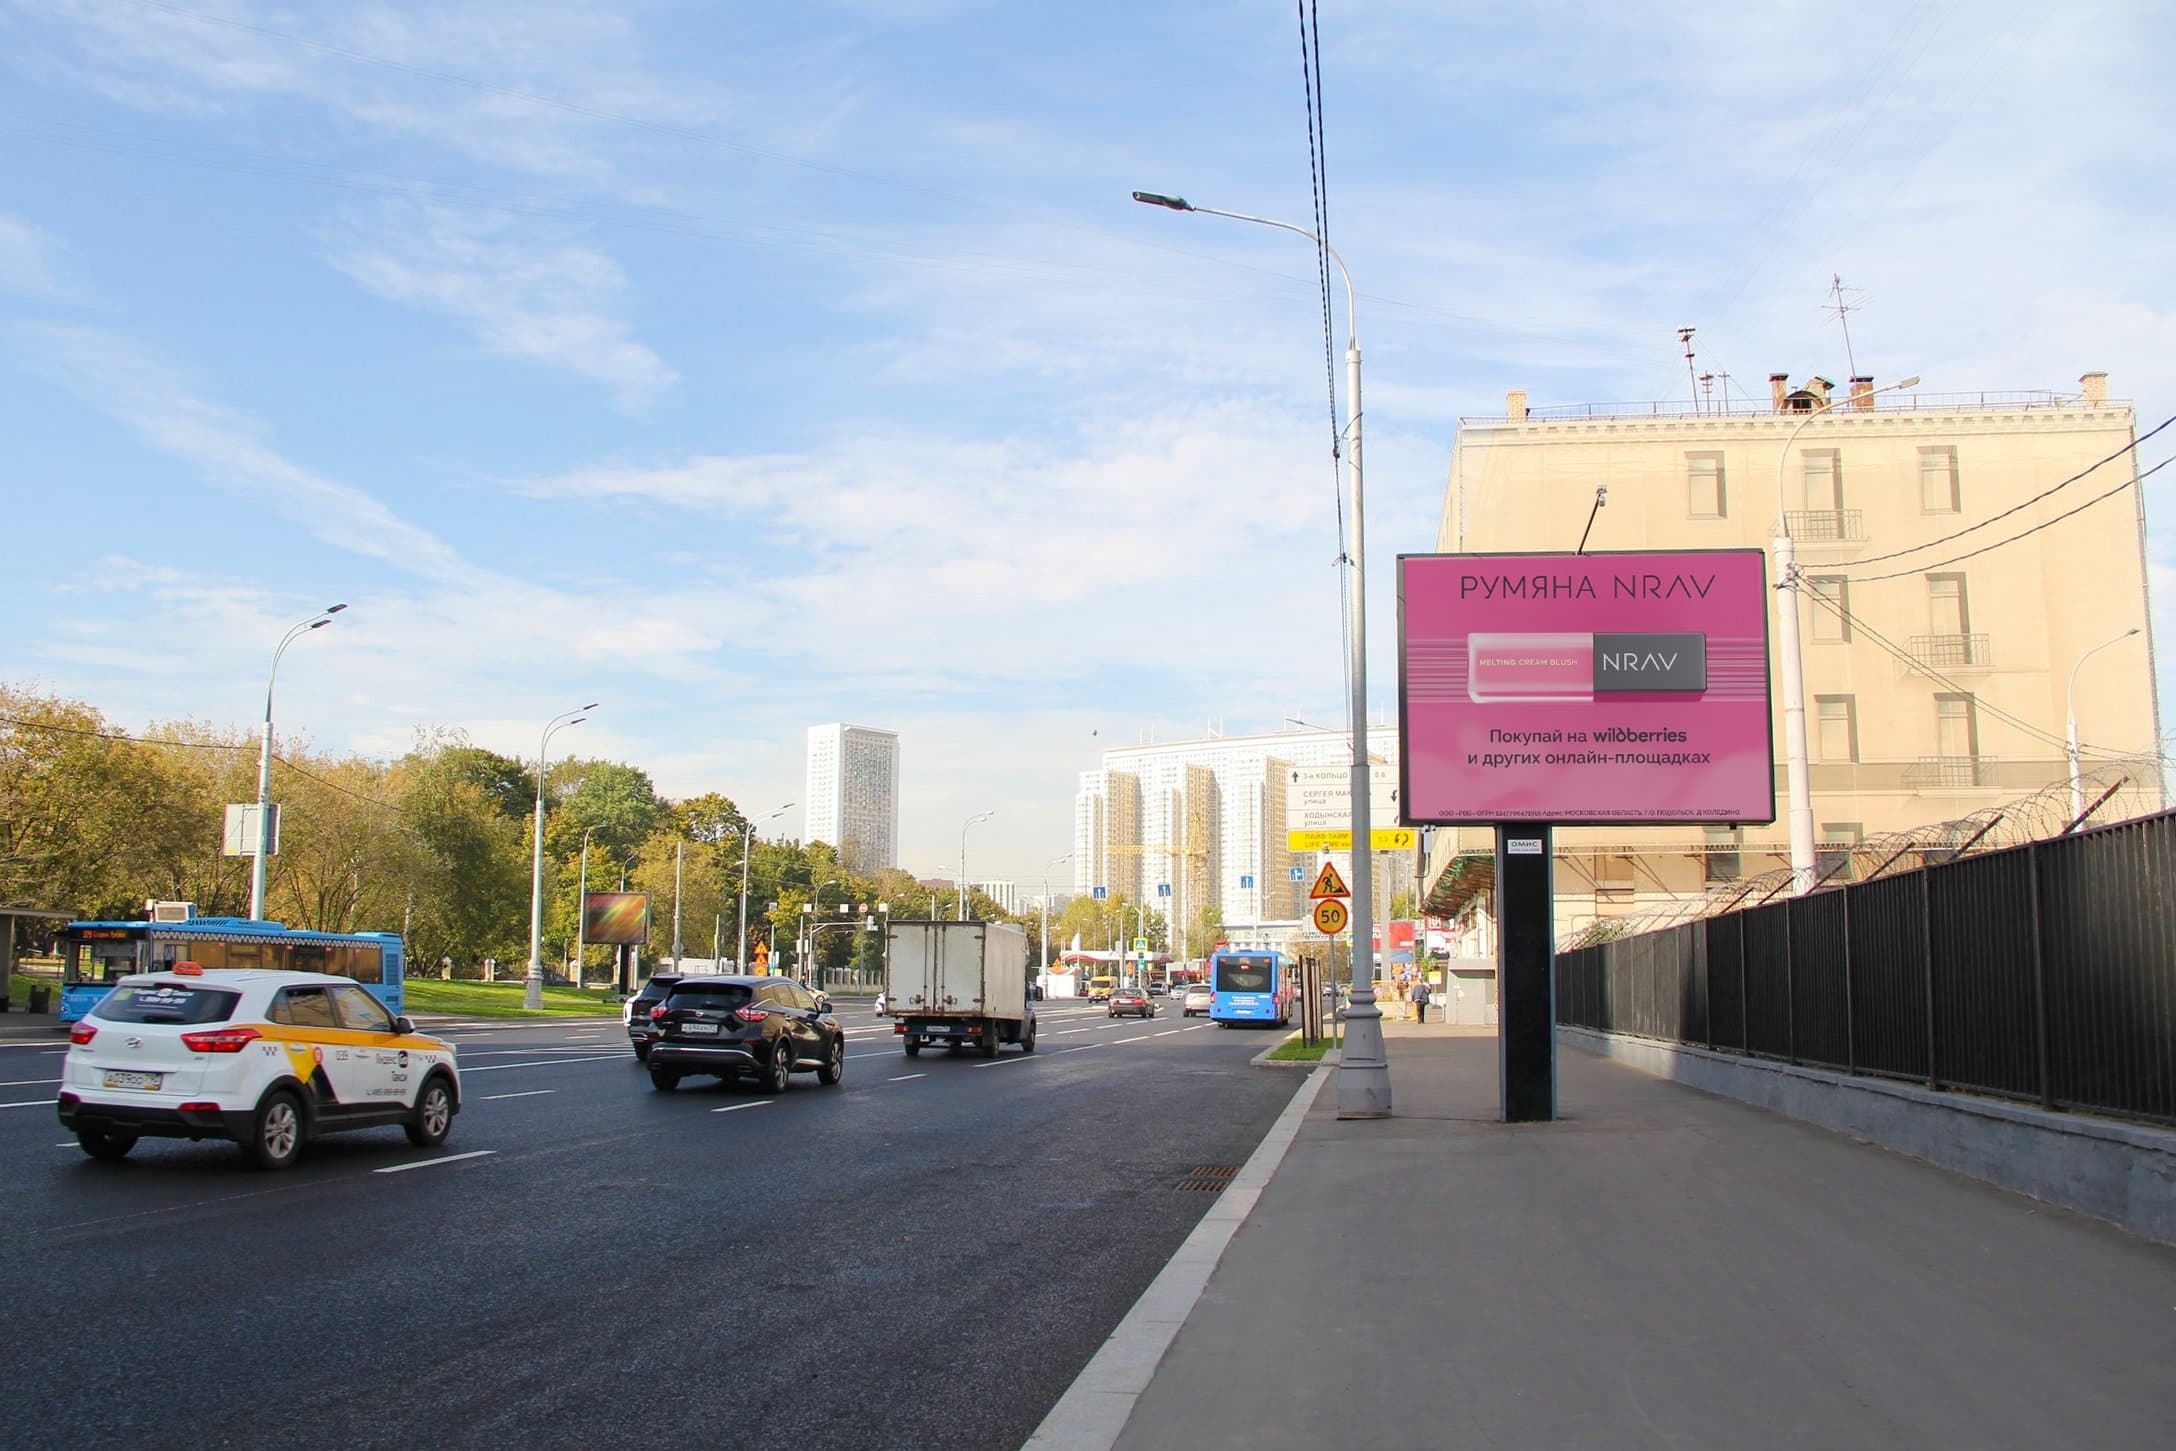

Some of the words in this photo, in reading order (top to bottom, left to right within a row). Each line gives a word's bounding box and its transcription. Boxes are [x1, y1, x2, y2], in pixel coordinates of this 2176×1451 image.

[1460, 574, 1596, 600] РУМЯНА
[1614, 574, 1716, 599] NRAV
[1479, 658, 1516, 666] MELTING
[1518, 658, 1548, 666] CREAM
[1550, 658, 1578, 666] BLUSH
[1603, 652, 1678, 671] NRAV
[1489, 728, 1562, 746] Покупай
[1567, 732, 1588, 743] на
[1593, 727, 1688, 743] wildberries
[1467, 754, 1478, 764] и
[1483, 753, 1541, 769] других
[1544, 750, 1711, 767] онлайн-площадках
[1316, 772, 1348, 780] КОЛЬЦО
[1303, 790, 1334, 798] СЕРГЕЯ
[1321, 909, 1340, 924] 50
